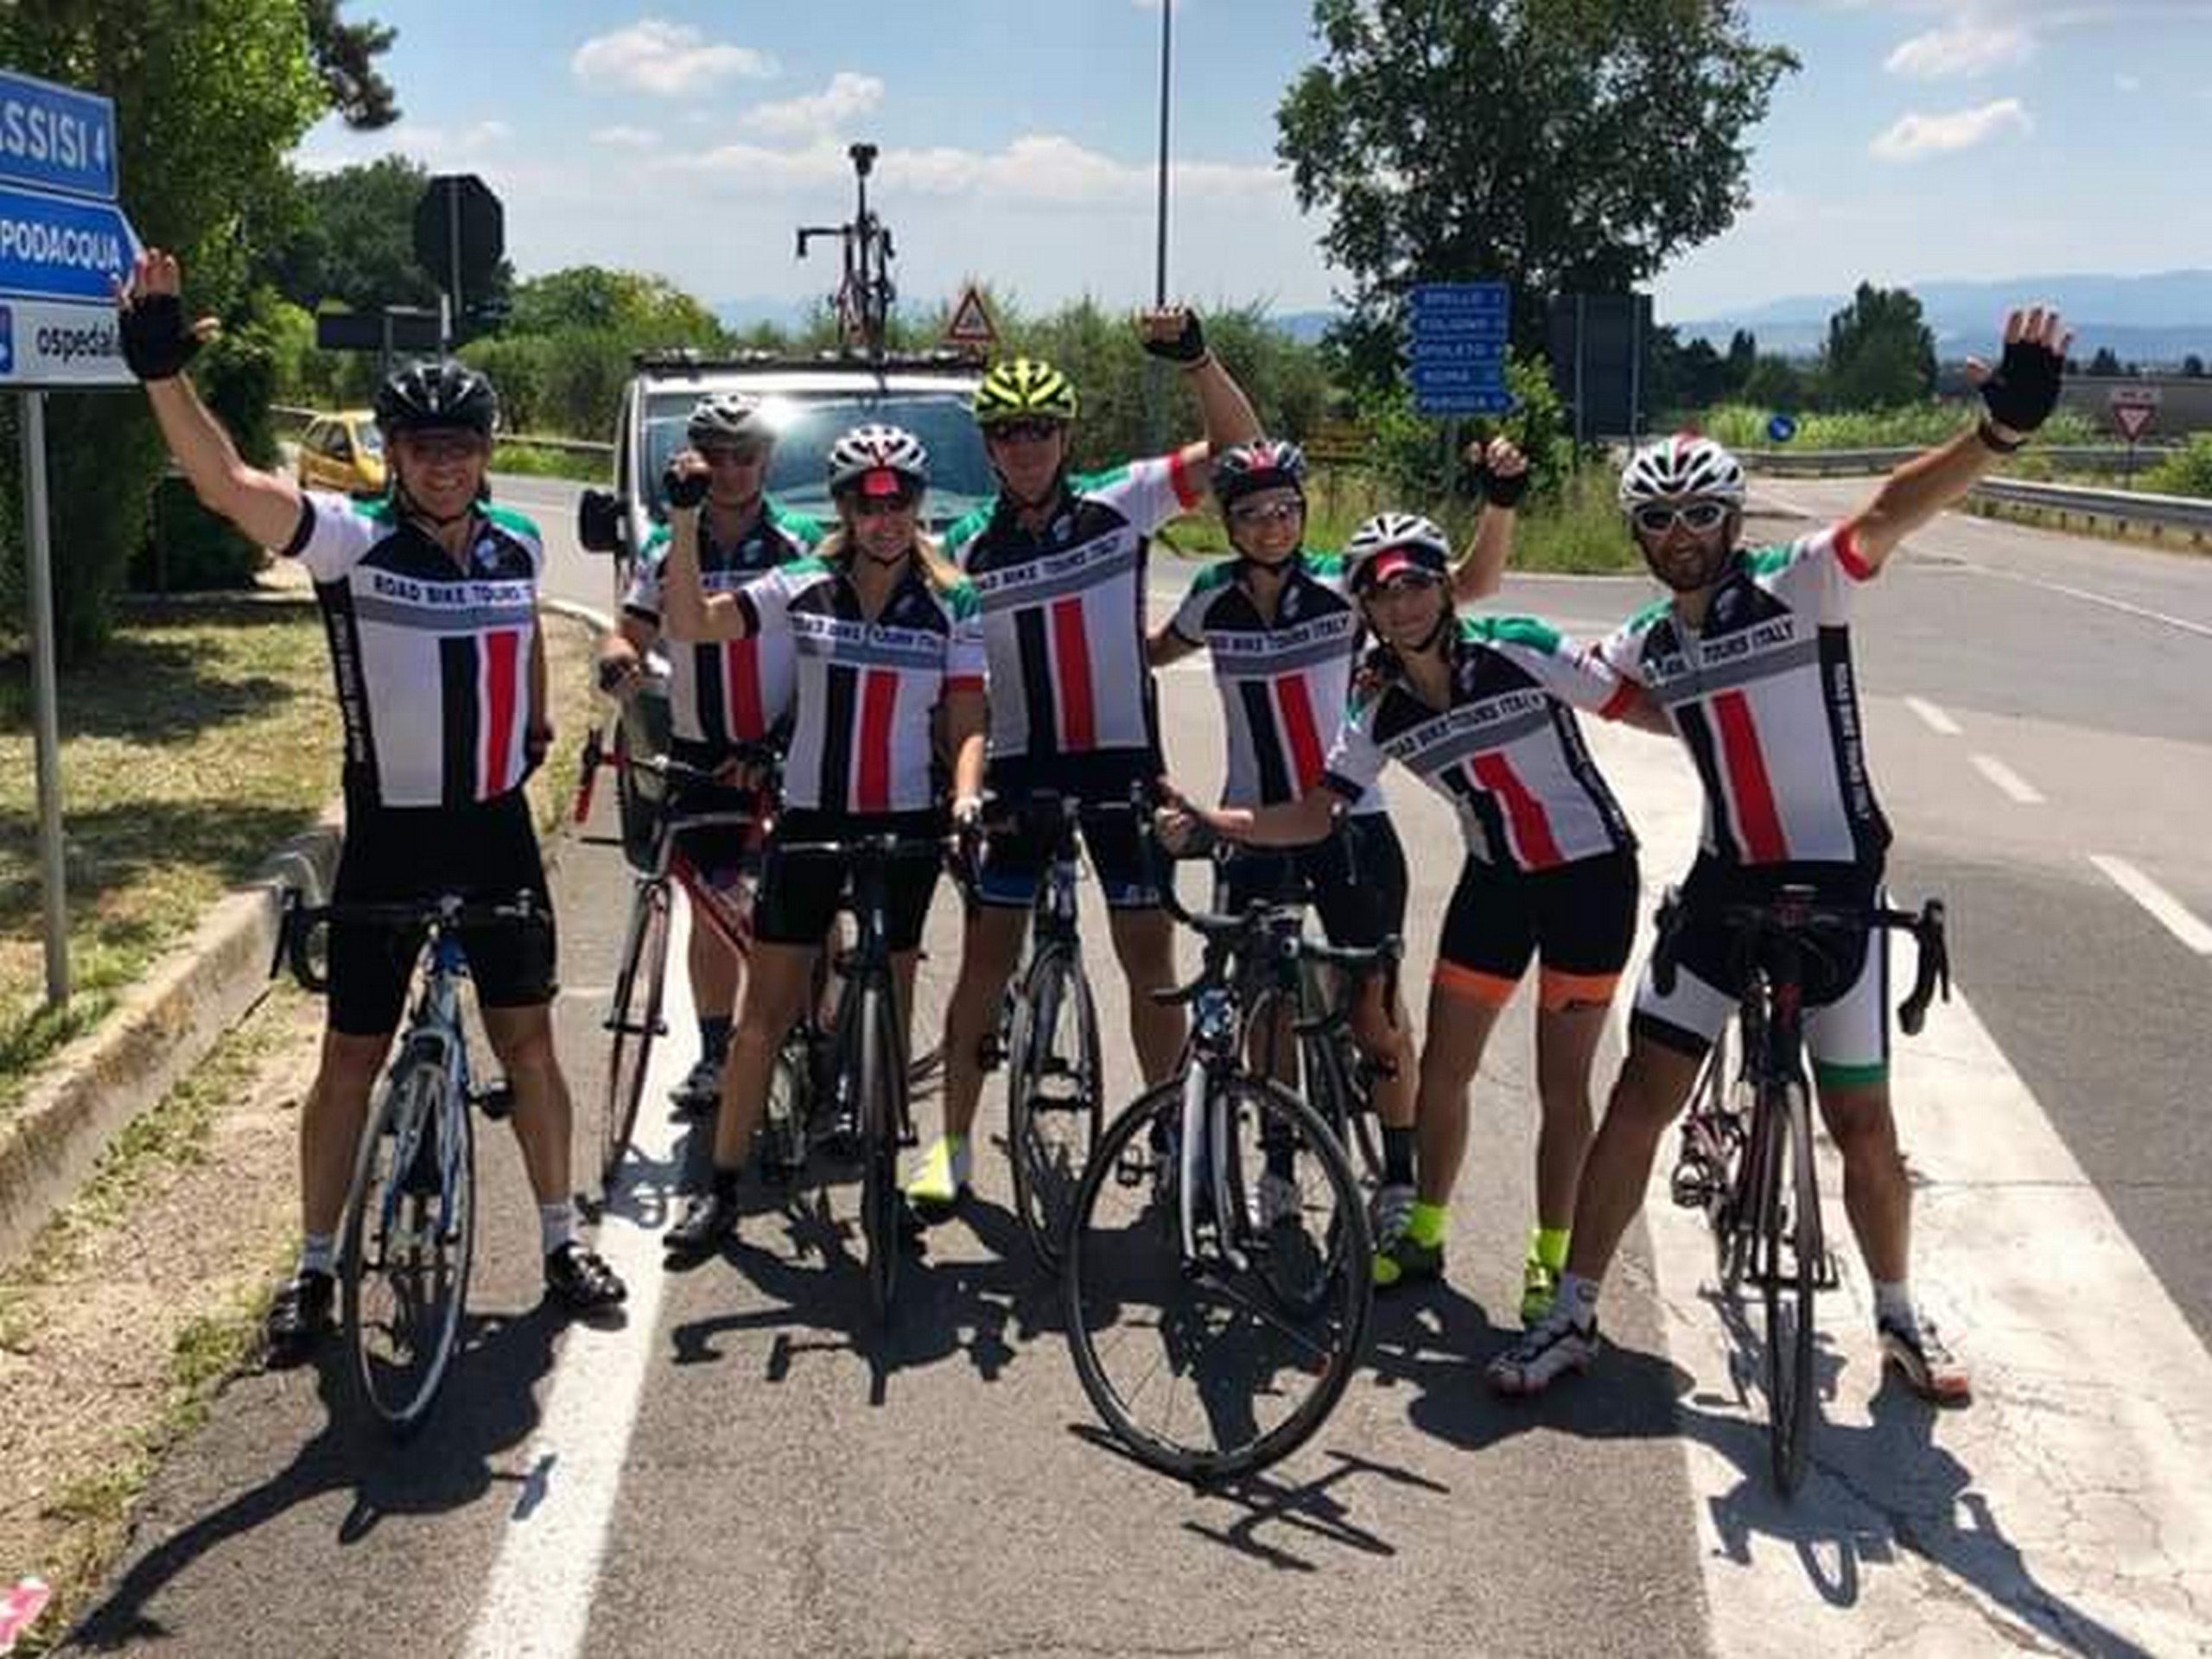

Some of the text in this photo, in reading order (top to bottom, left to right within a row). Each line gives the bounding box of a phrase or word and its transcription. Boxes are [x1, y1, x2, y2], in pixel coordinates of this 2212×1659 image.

[0, 100, 86, 172] SSISI
[373, 574, 422, 602] ROAD
[1752, 619, 1795, 648] ITALY
